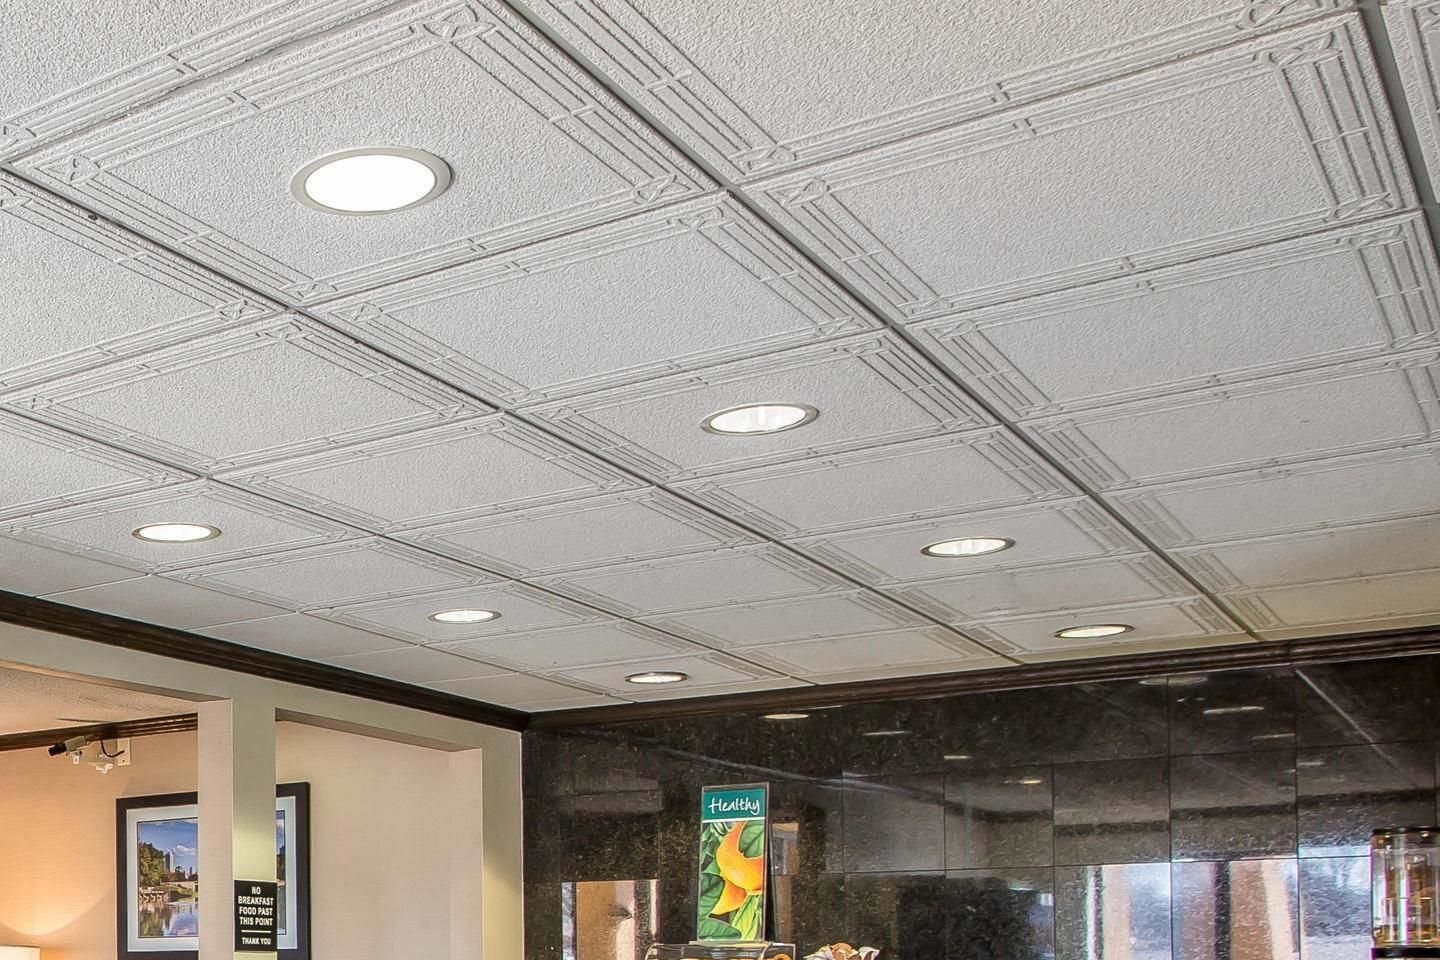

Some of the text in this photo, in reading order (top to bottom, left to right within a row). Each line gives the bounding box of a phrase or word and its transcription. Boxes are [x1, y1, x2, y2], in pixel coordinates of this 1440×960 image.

[708, 797, 760, 815] Healthy
[251, 886, 261, 895] NO
[237, 895, 274, 906] BREAKFAST
[239, 906, 273, 916] FOOD PAST
[239, 916, 273, 926] THIS POINT
[241, 937, 271, 945] THANK YOU
